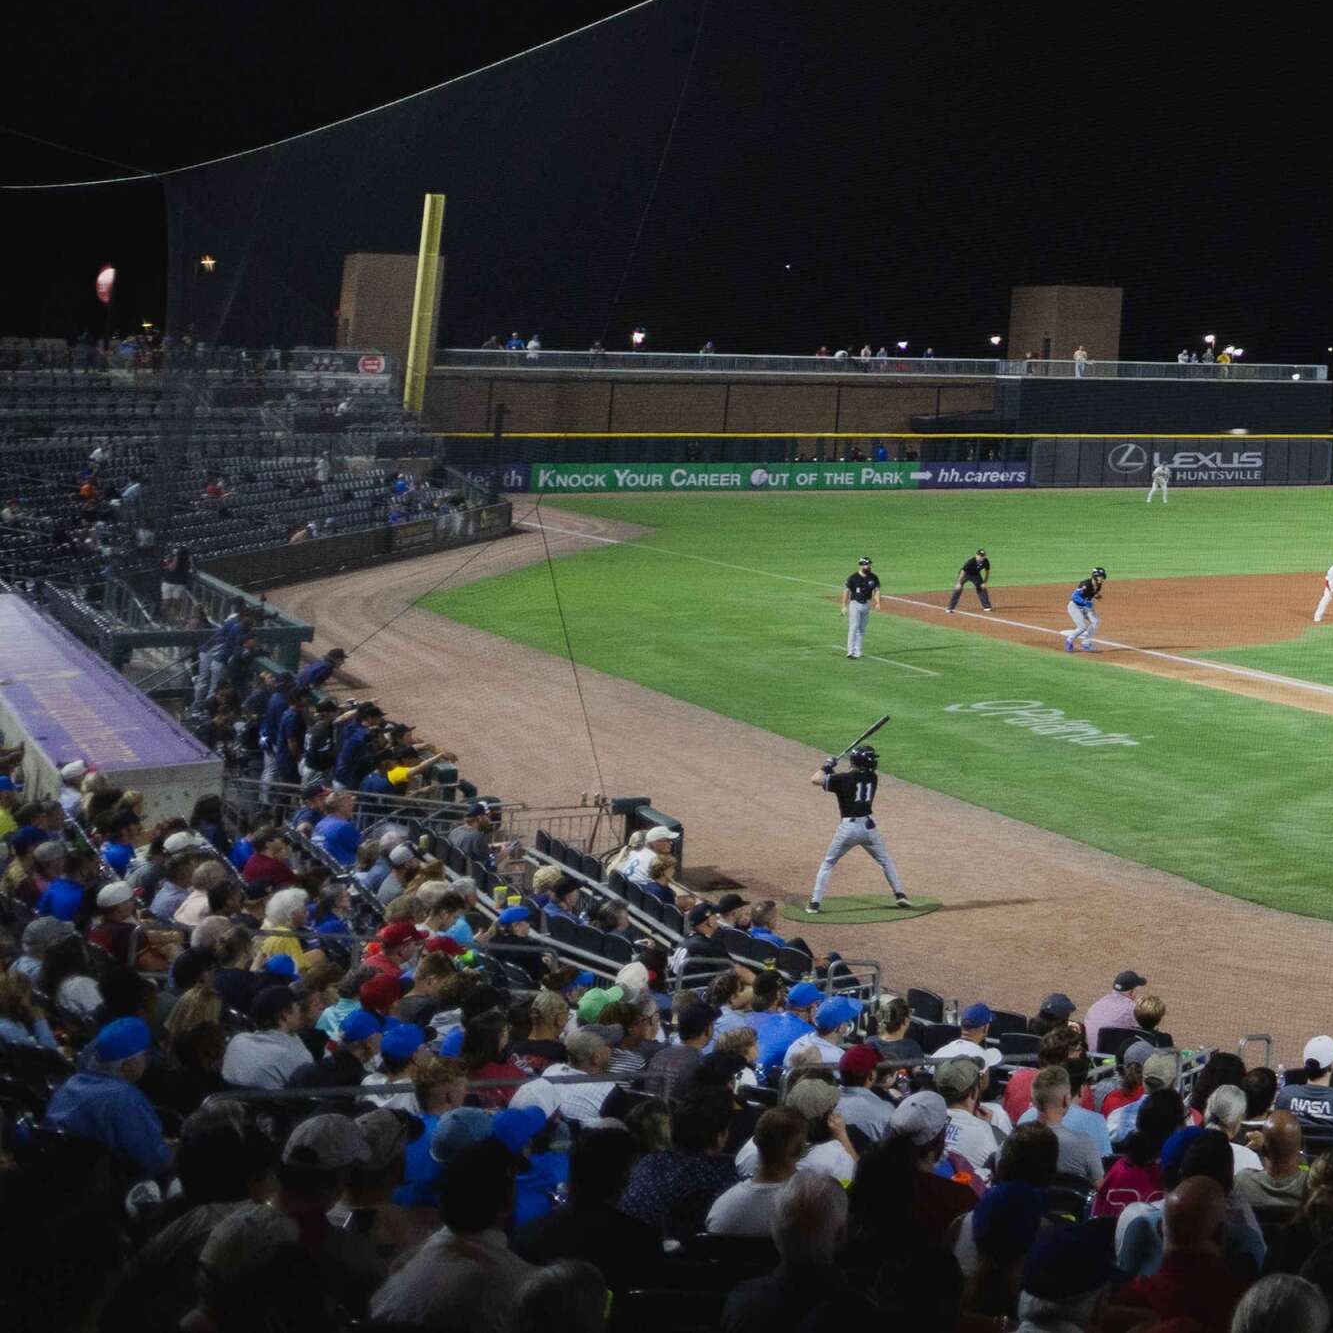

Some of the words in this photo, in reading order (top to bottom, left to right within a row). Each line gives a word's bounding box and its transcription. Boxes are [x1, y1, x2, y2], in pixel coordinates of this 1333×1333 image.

[1153, 450, 1263, 468] LEXUS
[937, 466, 1025, 484] hh.careers
[1177, 470, 1262, 482] HUNTSVILLE
[854, 781, 873, 803] 11
[1290, 1097, 1331, 1115] NASA
